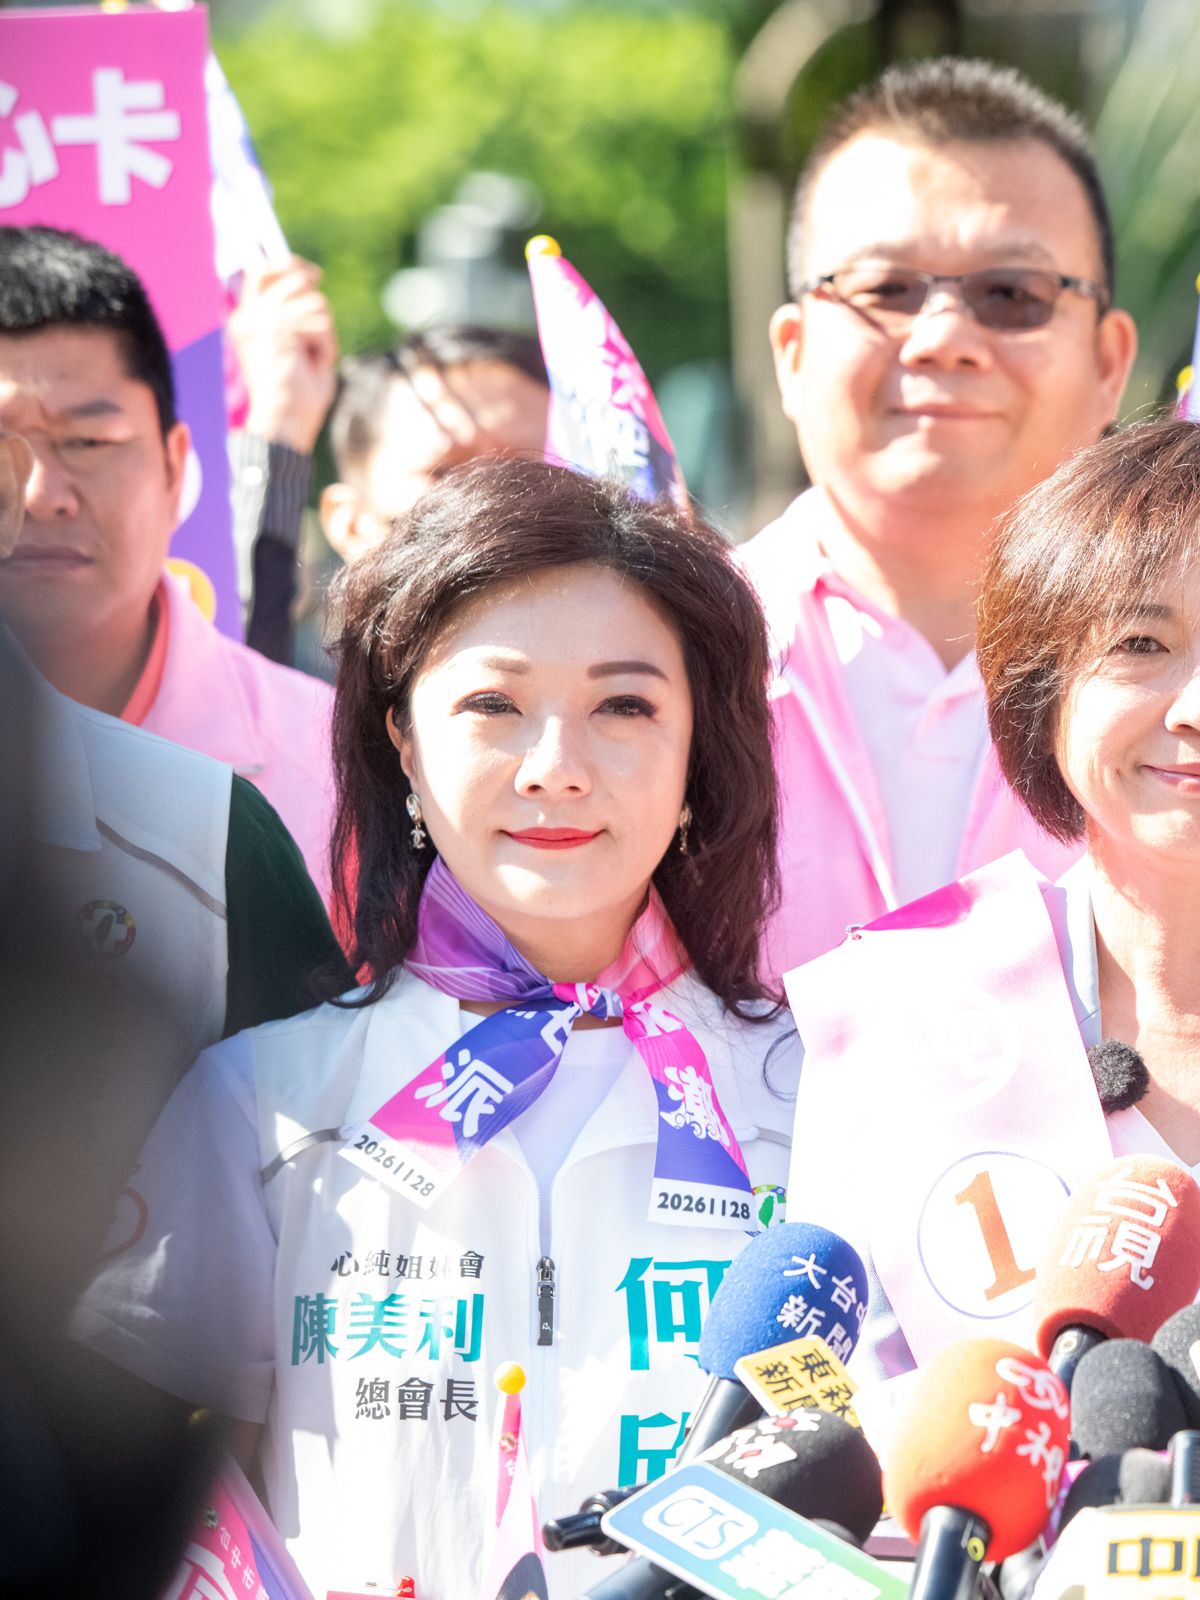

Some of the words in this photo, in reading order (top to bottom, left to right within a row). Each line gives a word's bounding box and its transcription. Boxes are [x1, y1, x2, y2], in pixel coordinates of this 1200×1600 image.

[414, 1049, 514, 1137] 派
[353, 1133, 437, 1198] 20261128
[656, 1191, 751, 1221] 20261128
[955, 1170, 1037, 1301] 1
[1056, 1166, 1178, 1291] 台視
[291, 1292, 485, 1366] 陳美利
[355, 1377, 479, 1422] 總會長
[657, 1497, 744, 1551] CTS
